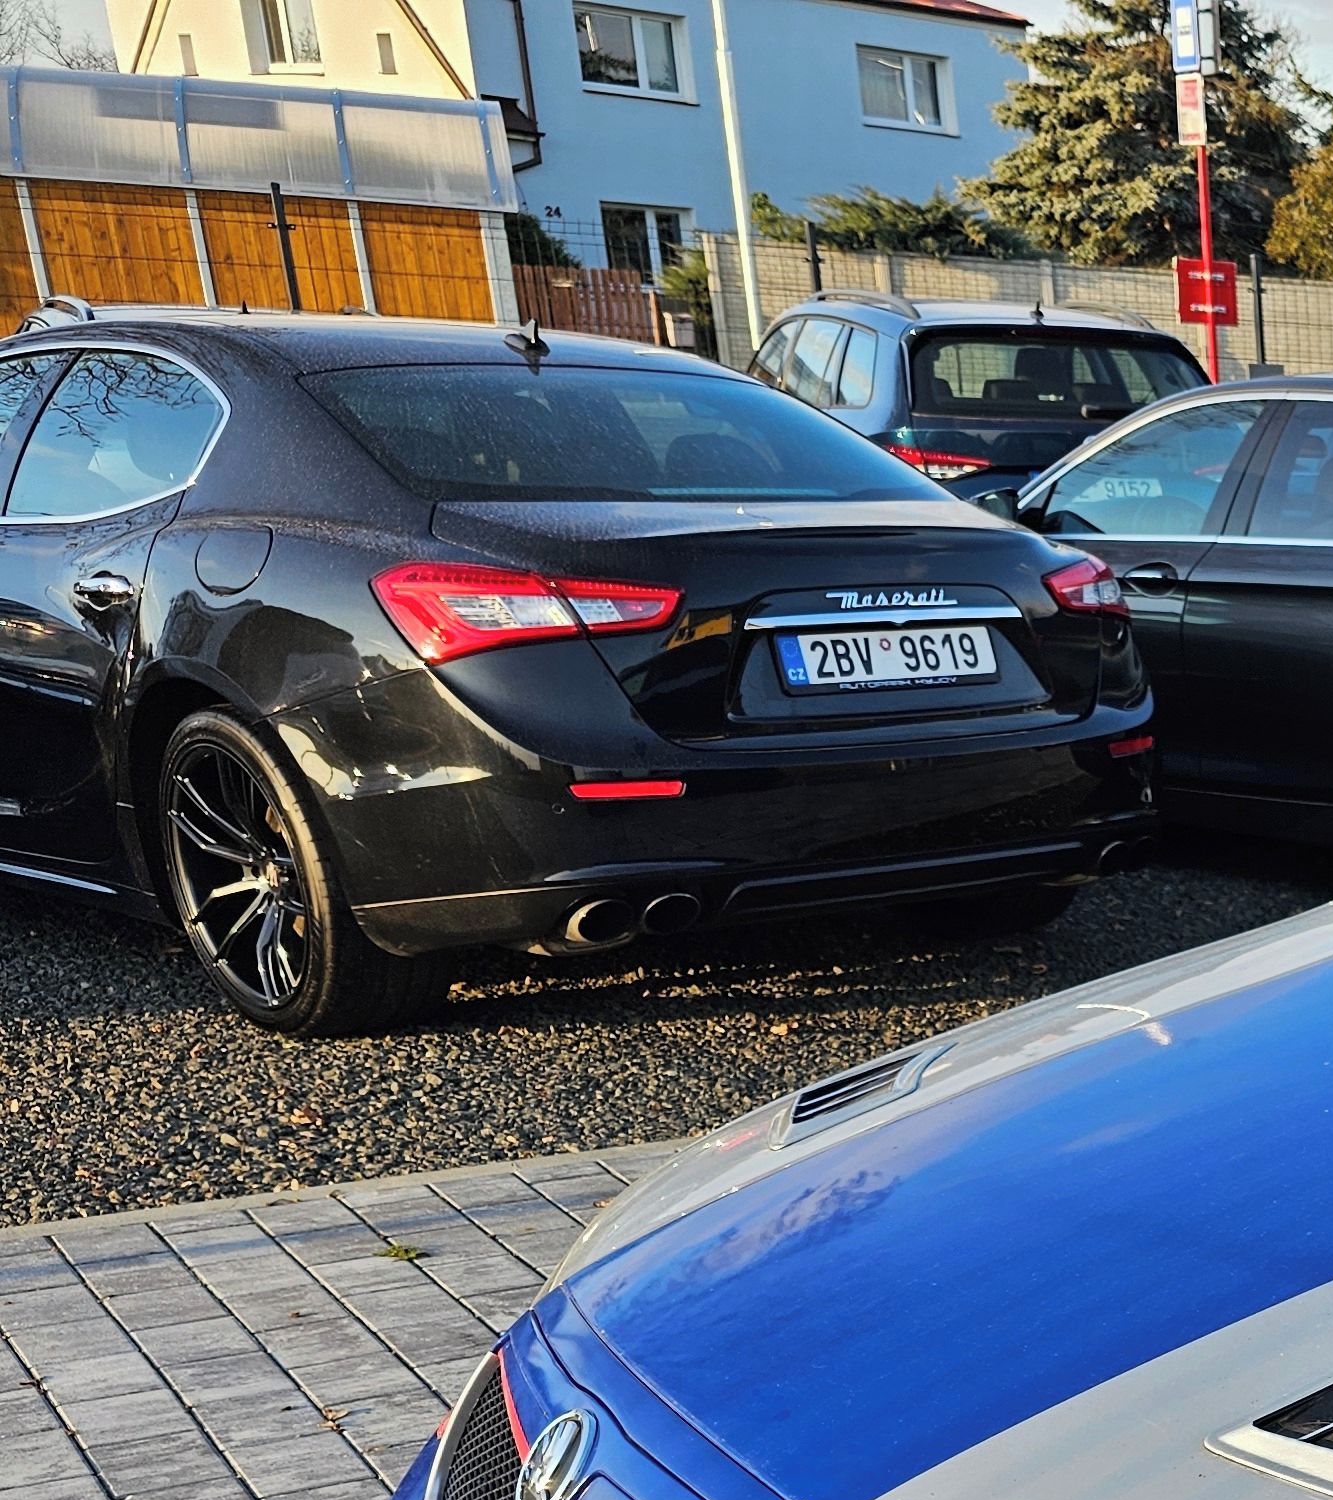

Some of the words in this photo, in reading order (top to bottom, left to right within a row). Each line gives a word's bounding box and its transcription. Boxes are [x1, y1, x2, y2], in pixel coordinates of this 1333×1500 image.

[544, 205, 562, 218] 24
[826, 588, 957, 609] Maserati
[810, 637, 874, 679] 2BV
[900, 632, 979, 672] 9619
[788, 667, 807, 681] CZ
